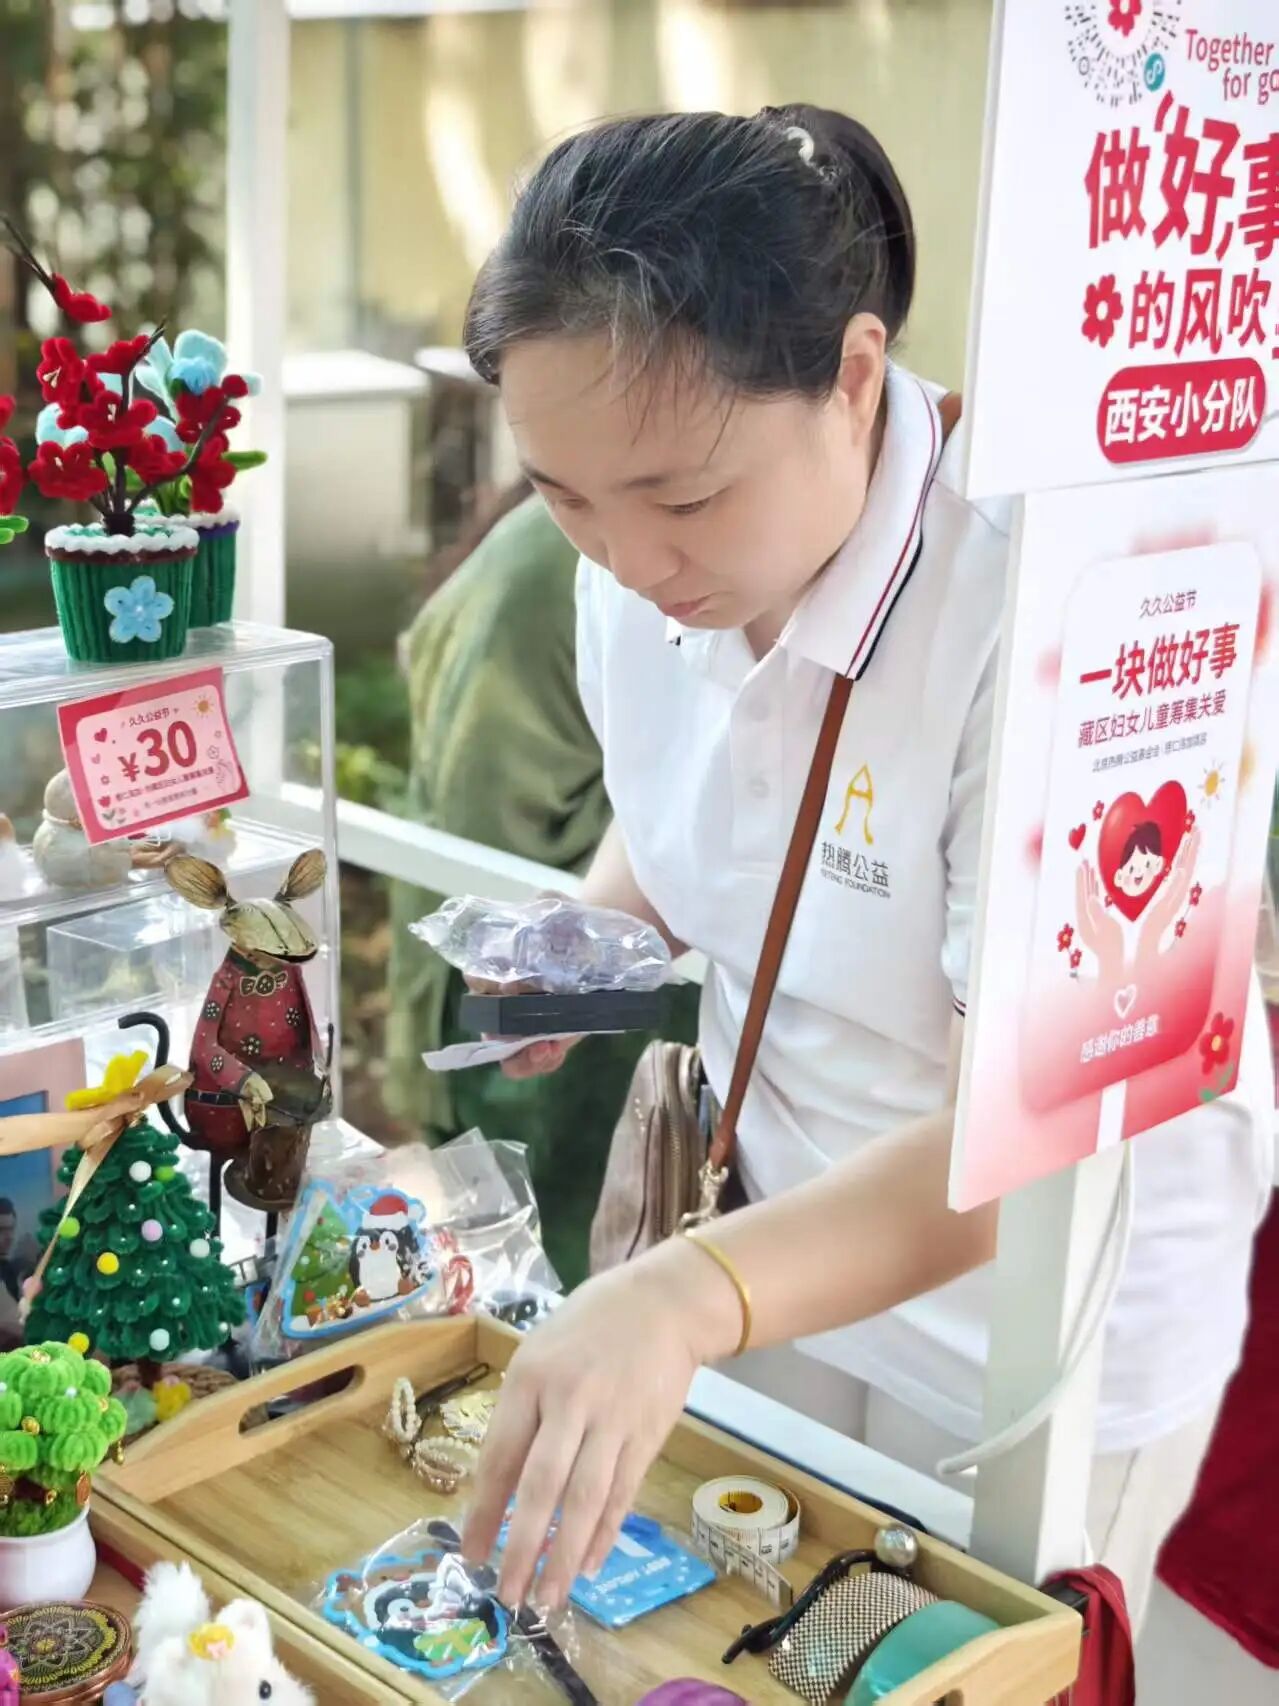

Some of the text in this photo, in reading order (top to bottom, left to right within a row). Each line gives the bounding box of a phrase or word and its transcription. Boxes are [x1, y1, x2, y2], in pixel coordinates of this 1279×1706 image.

[1185, 28, 1275, 72] Together
[1222, 66, 1252, 102] for
[1128, 267, 1279, 359] 的风吹
[1104, 375, 1259, 447] 西安小分队
[1139, 589, 1197, 619] 久久公益节
[1079, 622, 1240, 701] 一块做好事
[1078, 689, 1227, 748] 藏区妇女儿童筹集关爱
[117, 720, 198, 783] ¥30
